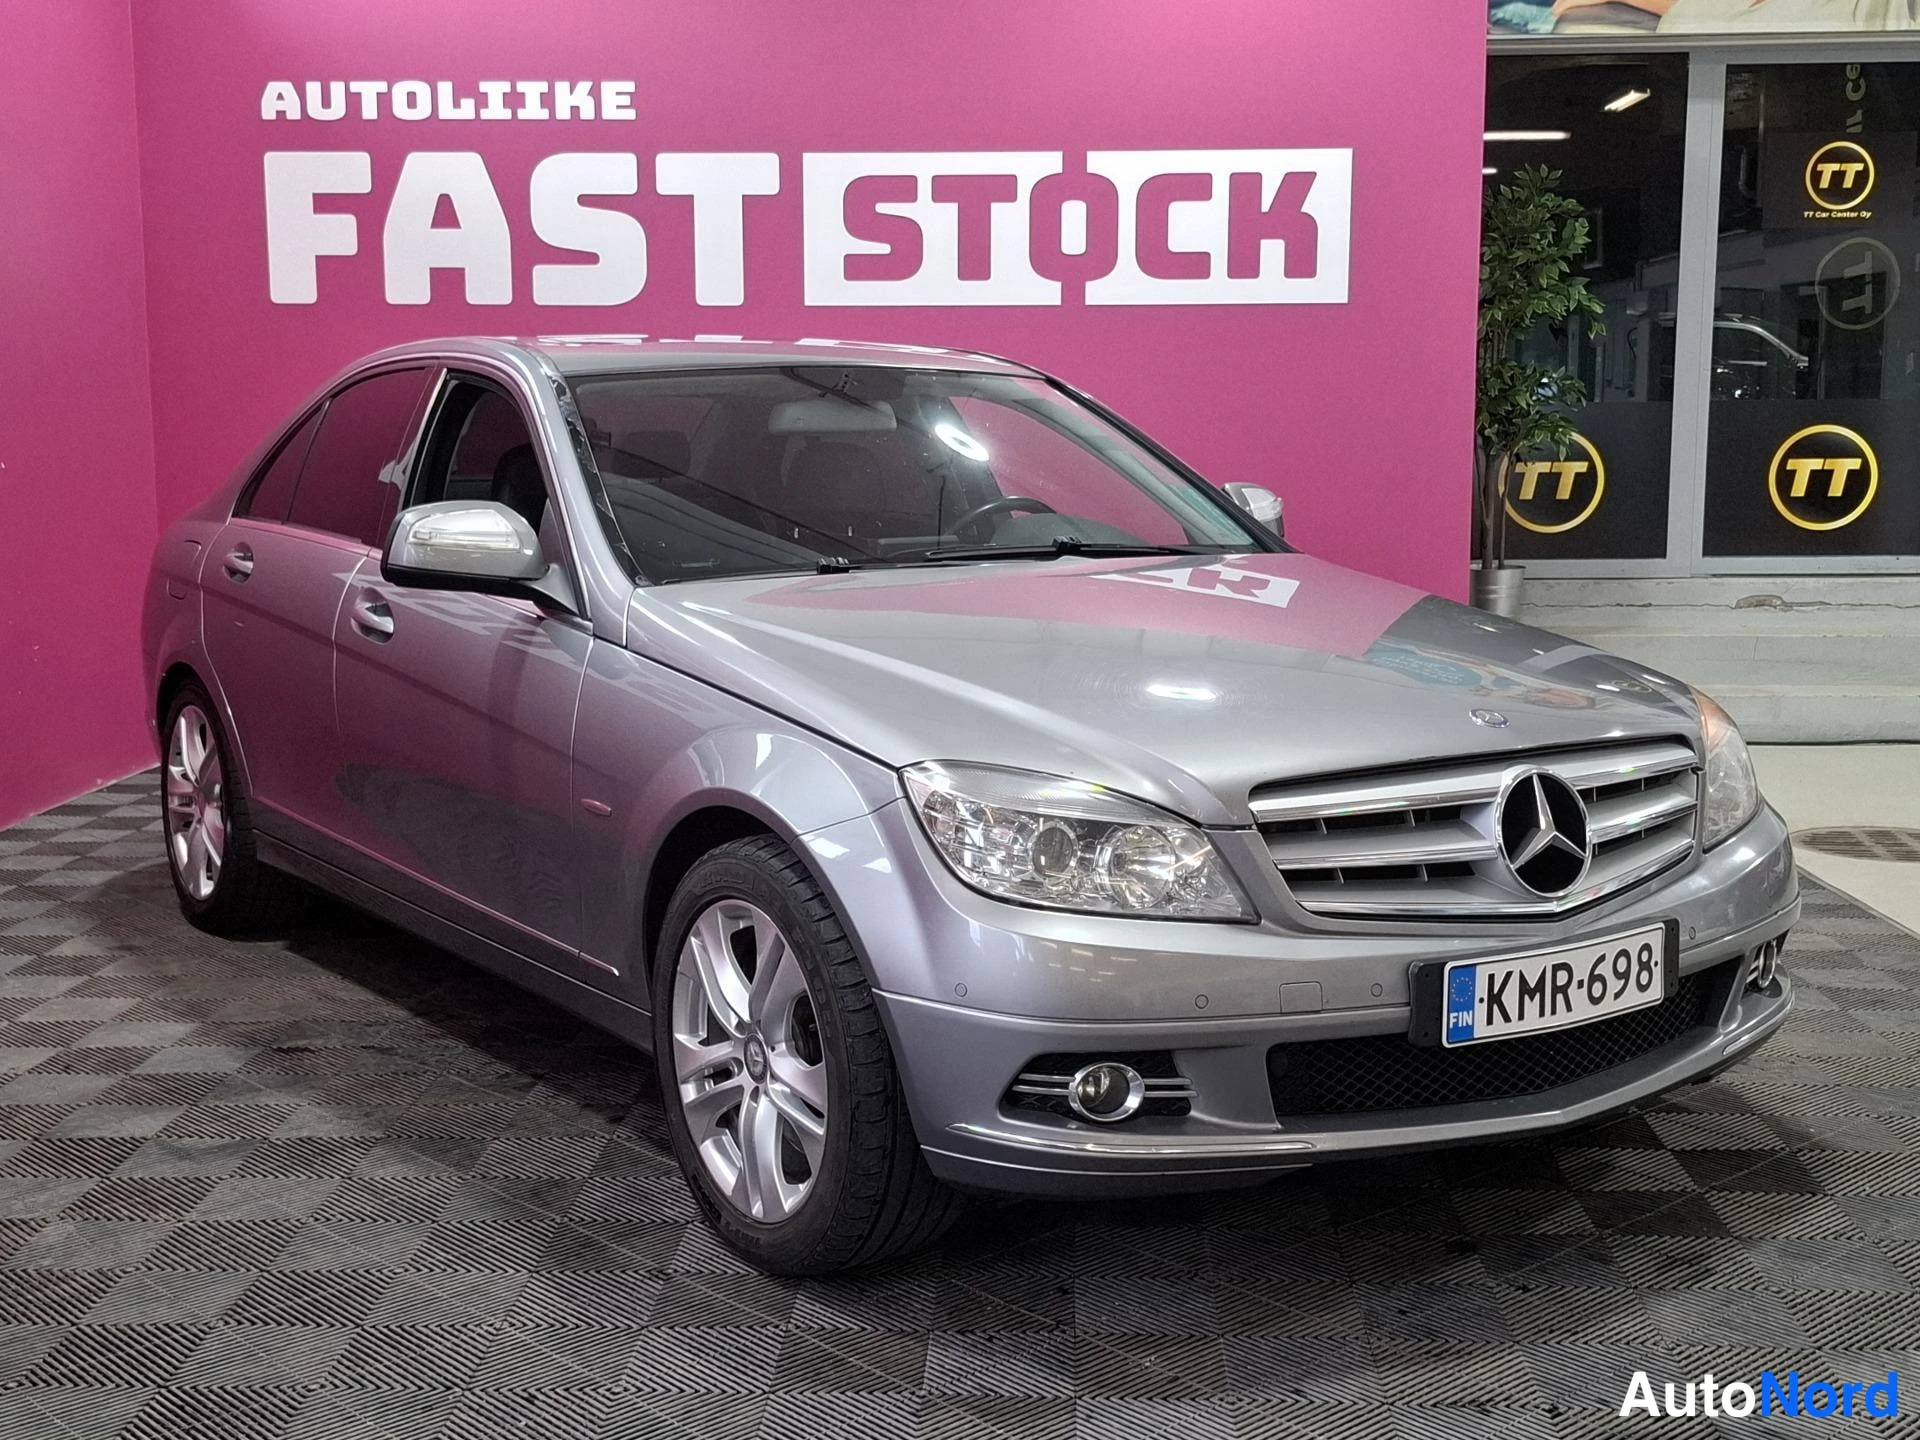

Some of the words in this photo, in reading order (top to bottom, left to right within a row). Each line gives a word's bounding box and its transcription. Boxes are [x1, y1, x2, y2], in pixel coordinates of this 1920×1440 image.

[261, 81, 637, 121] AUTOLIIKE
[1816, 163, 1864, 189] TT
[263, 152, 780, 306] FAST
[843, 170, 1318, 284] STOCK
[1860, 210, 1872, 219] Oy
[1515, 461, 1588, 500] TT
[1786, 458, 1862, 497] TT
[1449, 1010, 1473, 1029] FIN
